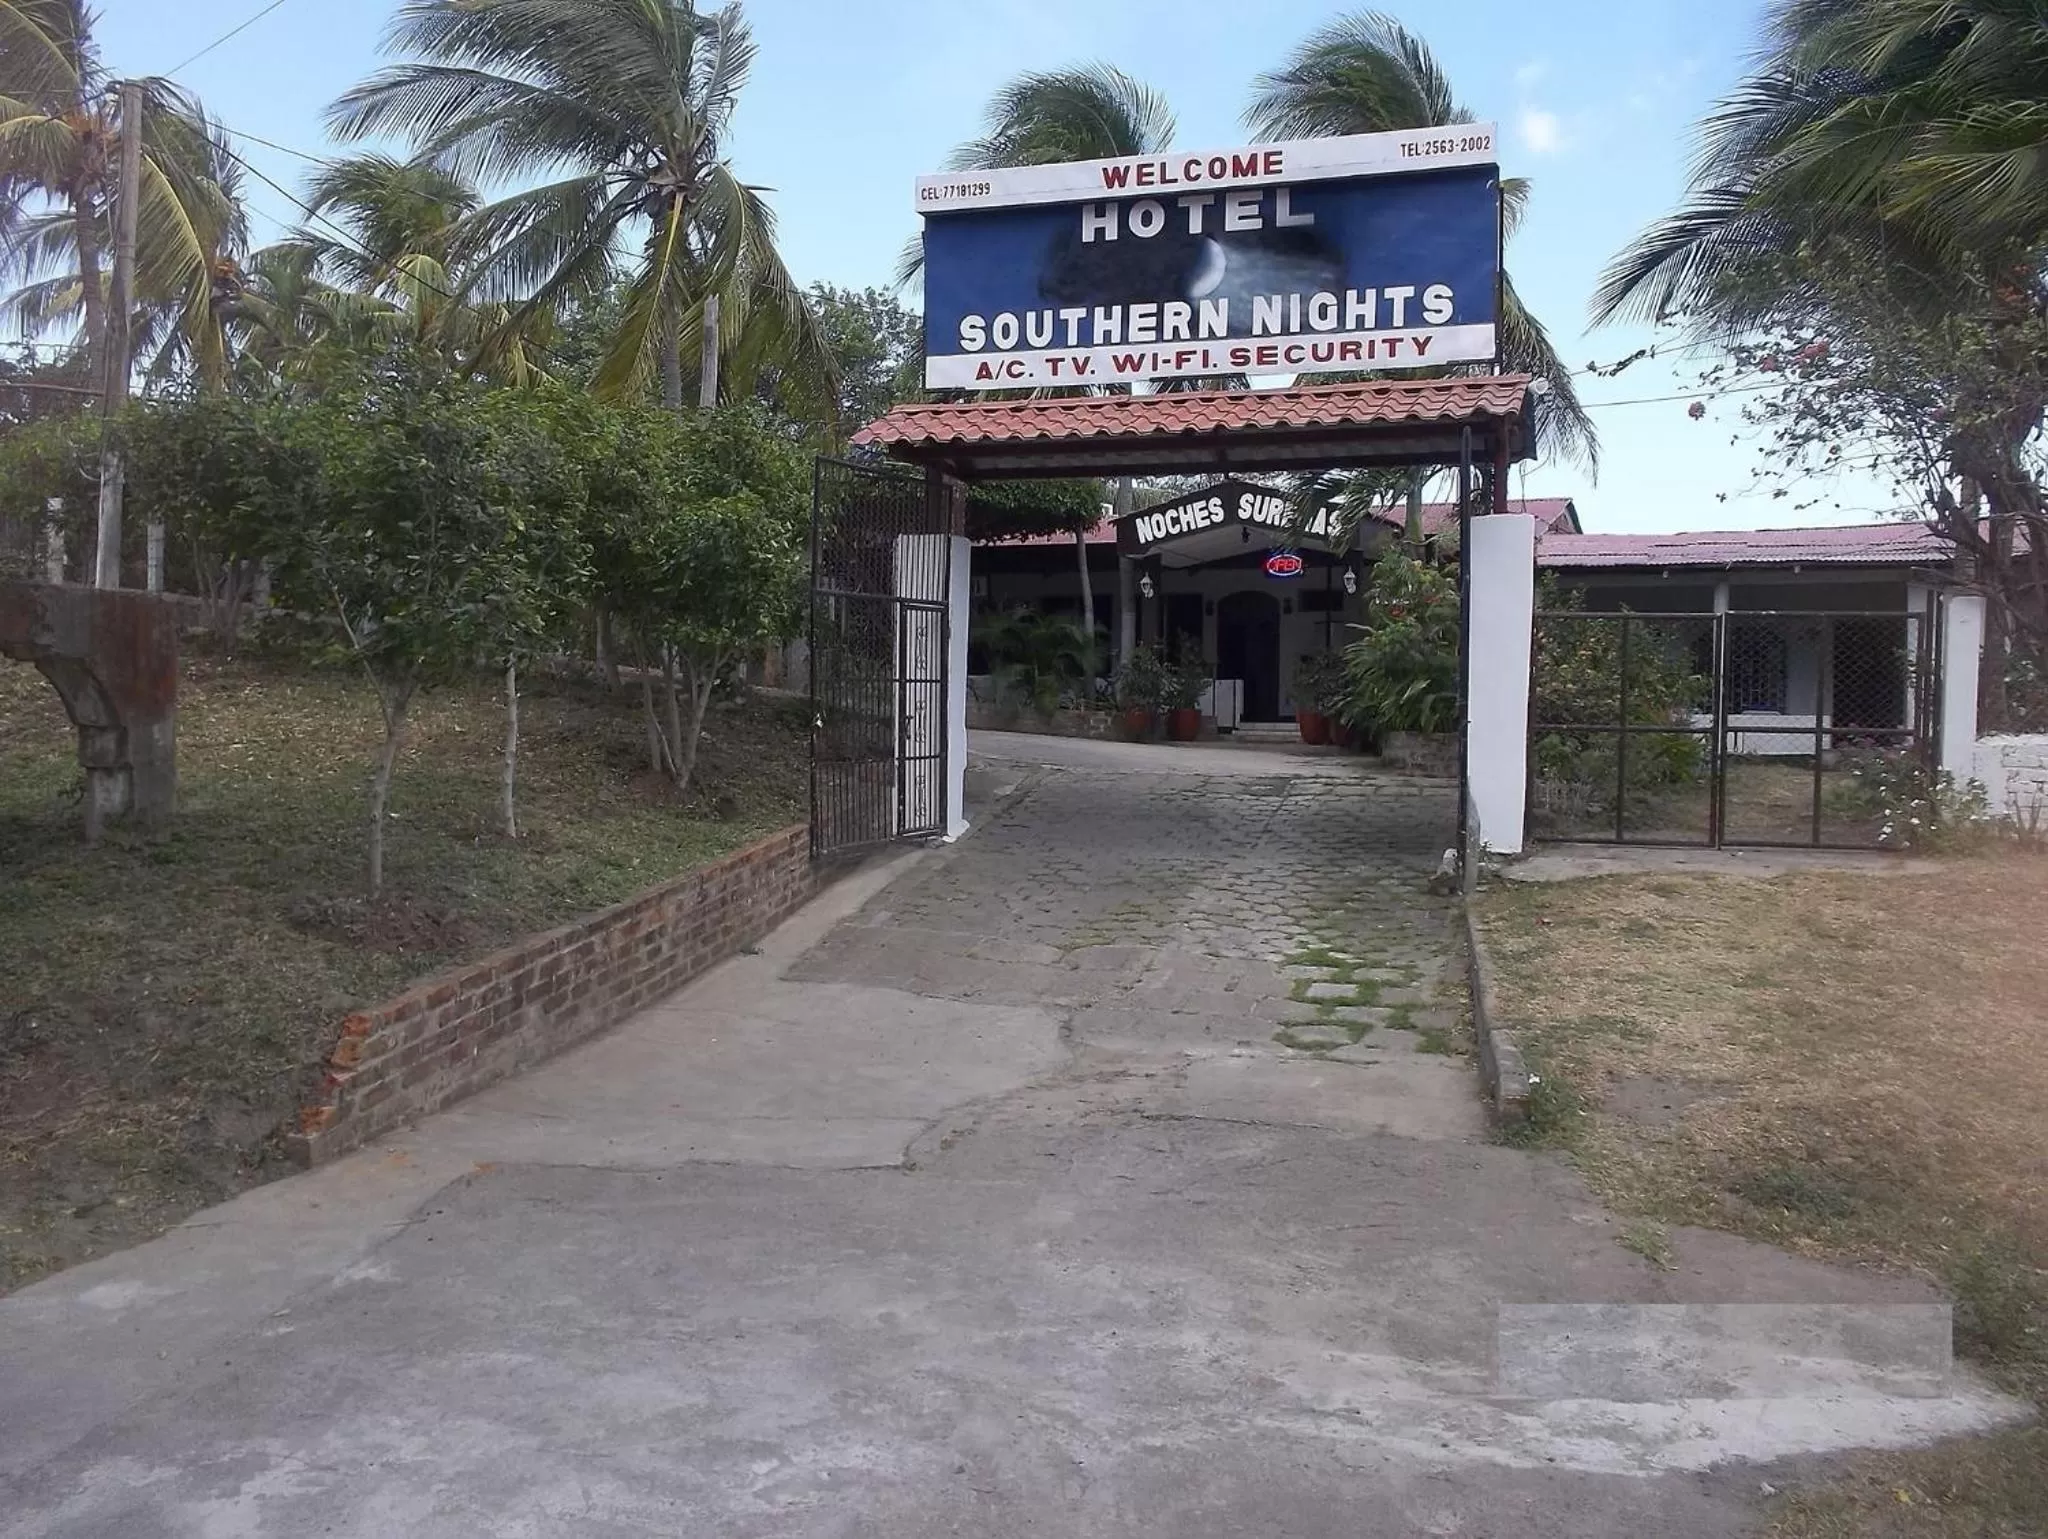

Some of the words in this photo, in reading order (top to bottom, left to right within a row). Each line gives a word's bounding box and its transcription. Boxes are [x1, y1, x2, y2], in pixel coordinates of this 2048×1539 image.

[1400, 135, 1491, 158] TEL:2563-2002
[920, 181, 991, 201] CEL:77181299
[1102, 150, 1283, 190] WELCOME
[1081, 186, 1315, 243] HOTEL
[959, 298, 1229, 352] SOUTHERN
[1252, 283, 1454, 336] NIGHTS
[1045, 355, 1096, 378] TV.
[1230, 335, 1433, 367] SECURITY
[1135, 496, 1225, 544] NOCHES
